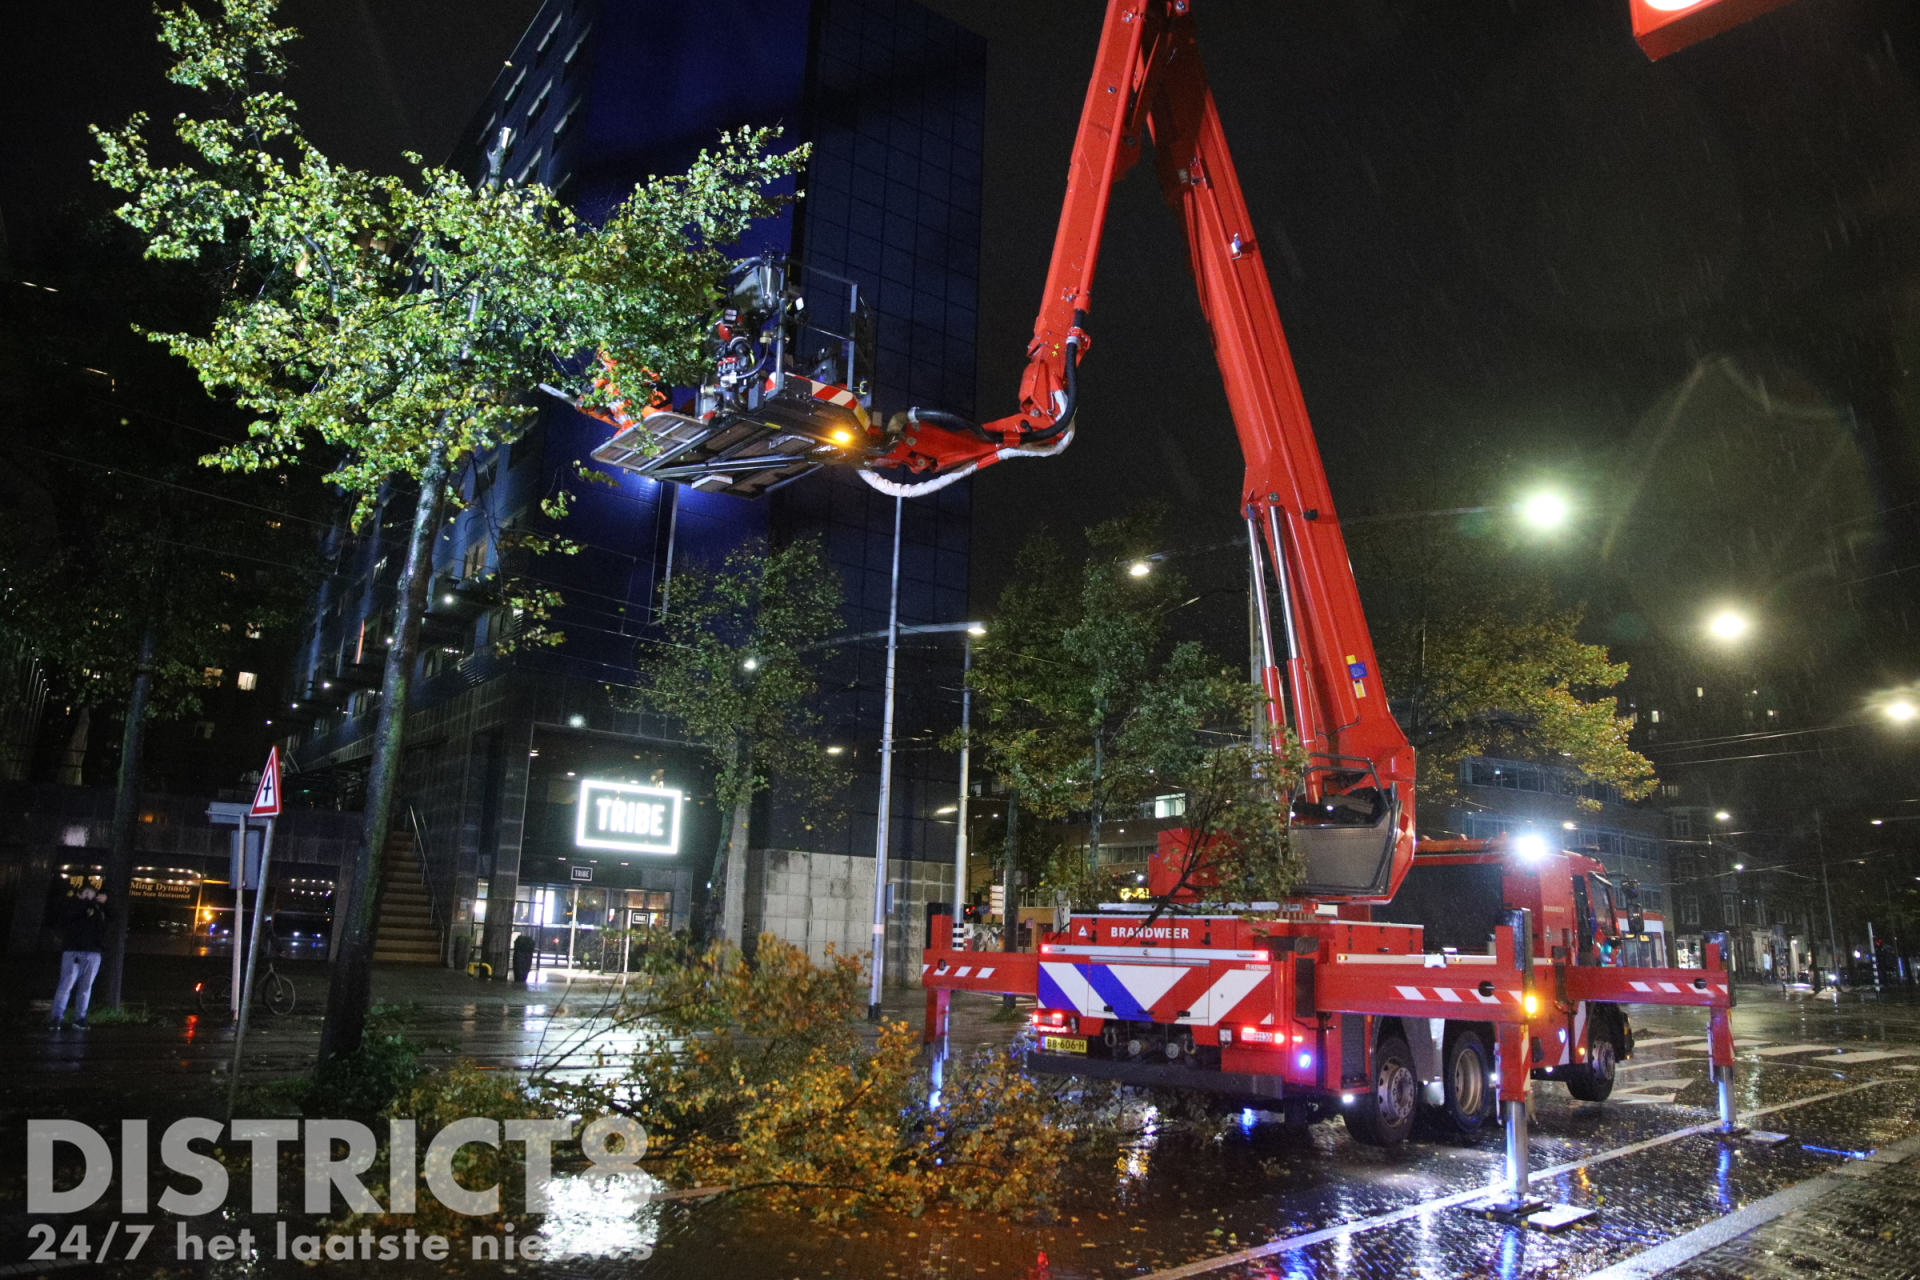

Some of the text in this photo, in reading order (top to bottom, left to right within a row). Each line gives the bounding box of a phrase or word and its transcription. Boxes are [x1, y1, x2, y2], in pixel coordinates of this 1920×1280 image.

[597, 798, 665, 836] TRIBE
[575, 869, 590, 878] TRIBE
[129, 881, 192, 893] Ming Dynasty
[1110, 926, 1190, 939] BRANDWEER
